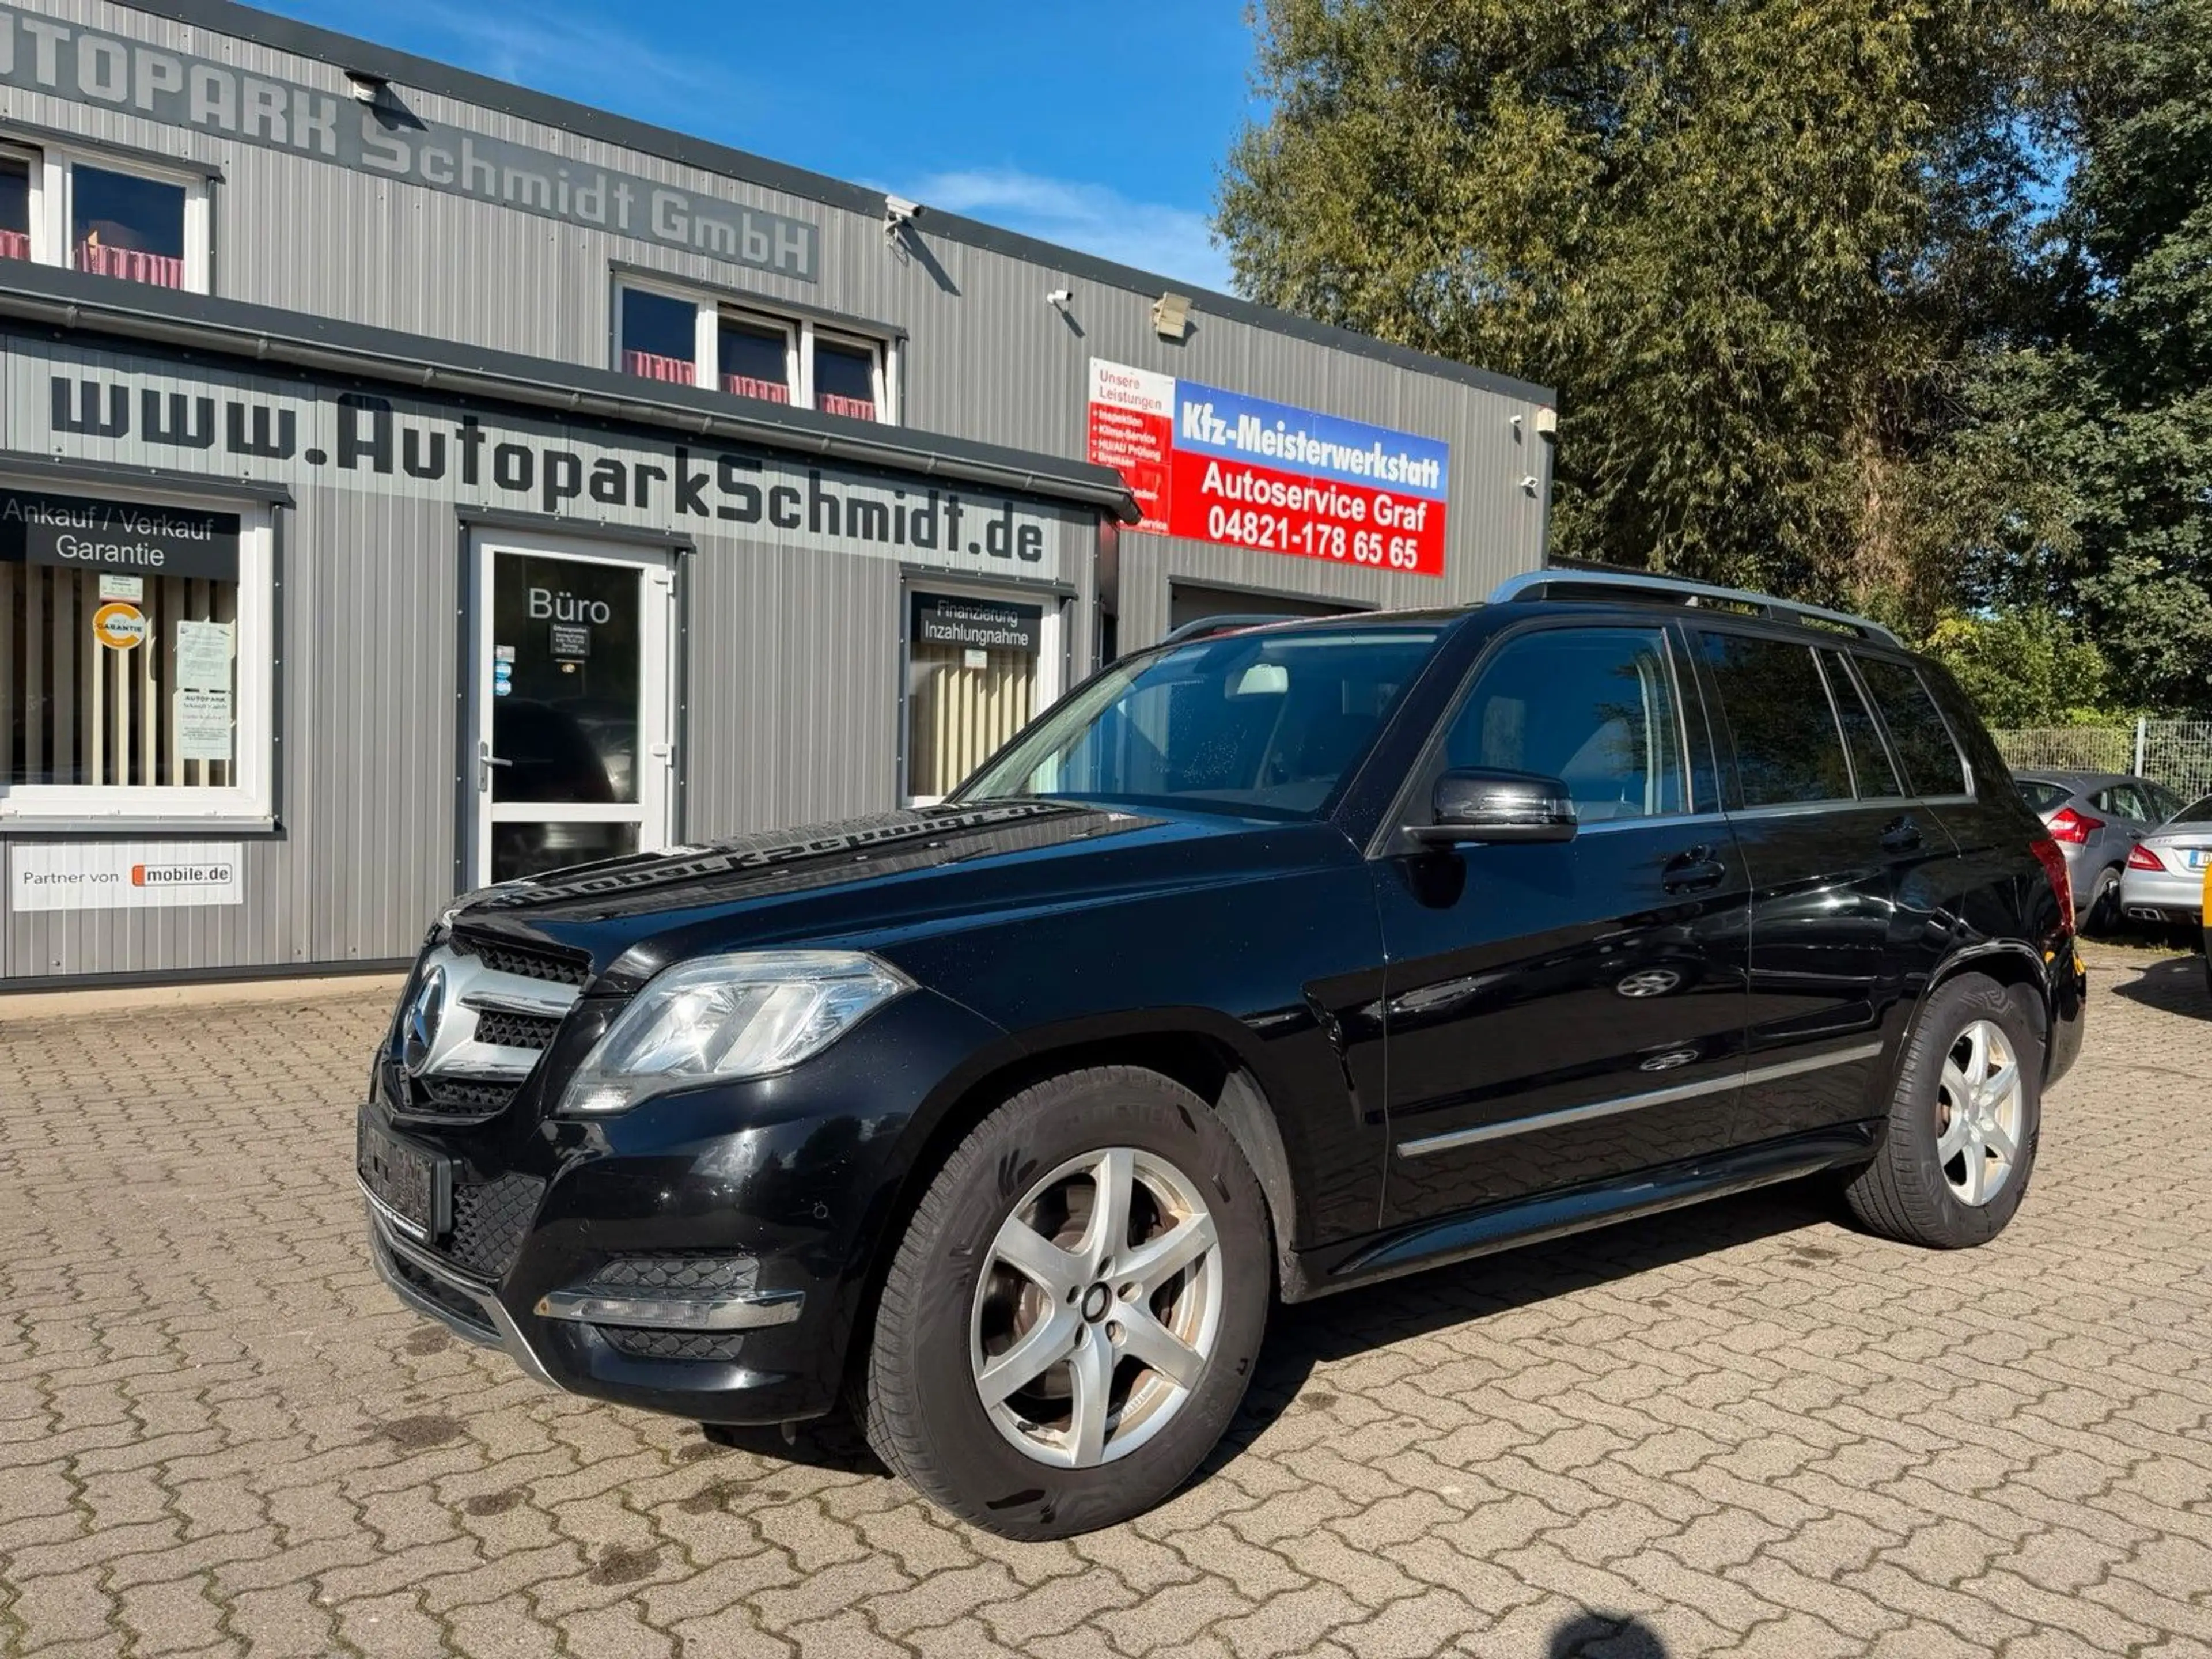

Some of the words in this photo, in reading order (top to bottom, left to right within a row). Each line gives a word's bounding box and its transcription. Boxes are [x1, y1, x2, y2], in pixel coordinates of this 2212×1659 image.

[361, 112, 634, 229] Schmidt
[651, 188, 808, 274] GmbH
[1100, 369, 1140, 389] Unsere
[1099, 386, 1162, 410] Leistungen
[1182, 401, 1440, 490] Kfz-Meisterwerkstatt
[51, 376, 1043, 563] www.AutoparkSchmidt.de
[1202, 461, 1366, 522] Autoservice
[1373, 494, 1427, 532] Graf
[3, 498, 96, 529] Ankauf
[102, 507, 112, 531] /
[120, 509, 214, 541] Verkauf
[1209, 505, 1346, 558] 04821-178
[1353, 531, 1382, 567] 65
[1389, 538, 1418, 570] 65
[56, 535, 165, 567] Garantie
[529, 588, 611, 624] Büro
[937, 599, 1018, 628] Finanzierung
[925, 620, 1029, 646] Inzahlungnahme
[23, 872, 85, 885] Partner
[89, 872, 119, 884] von
[147, 865, 229, 882] mobile.de
